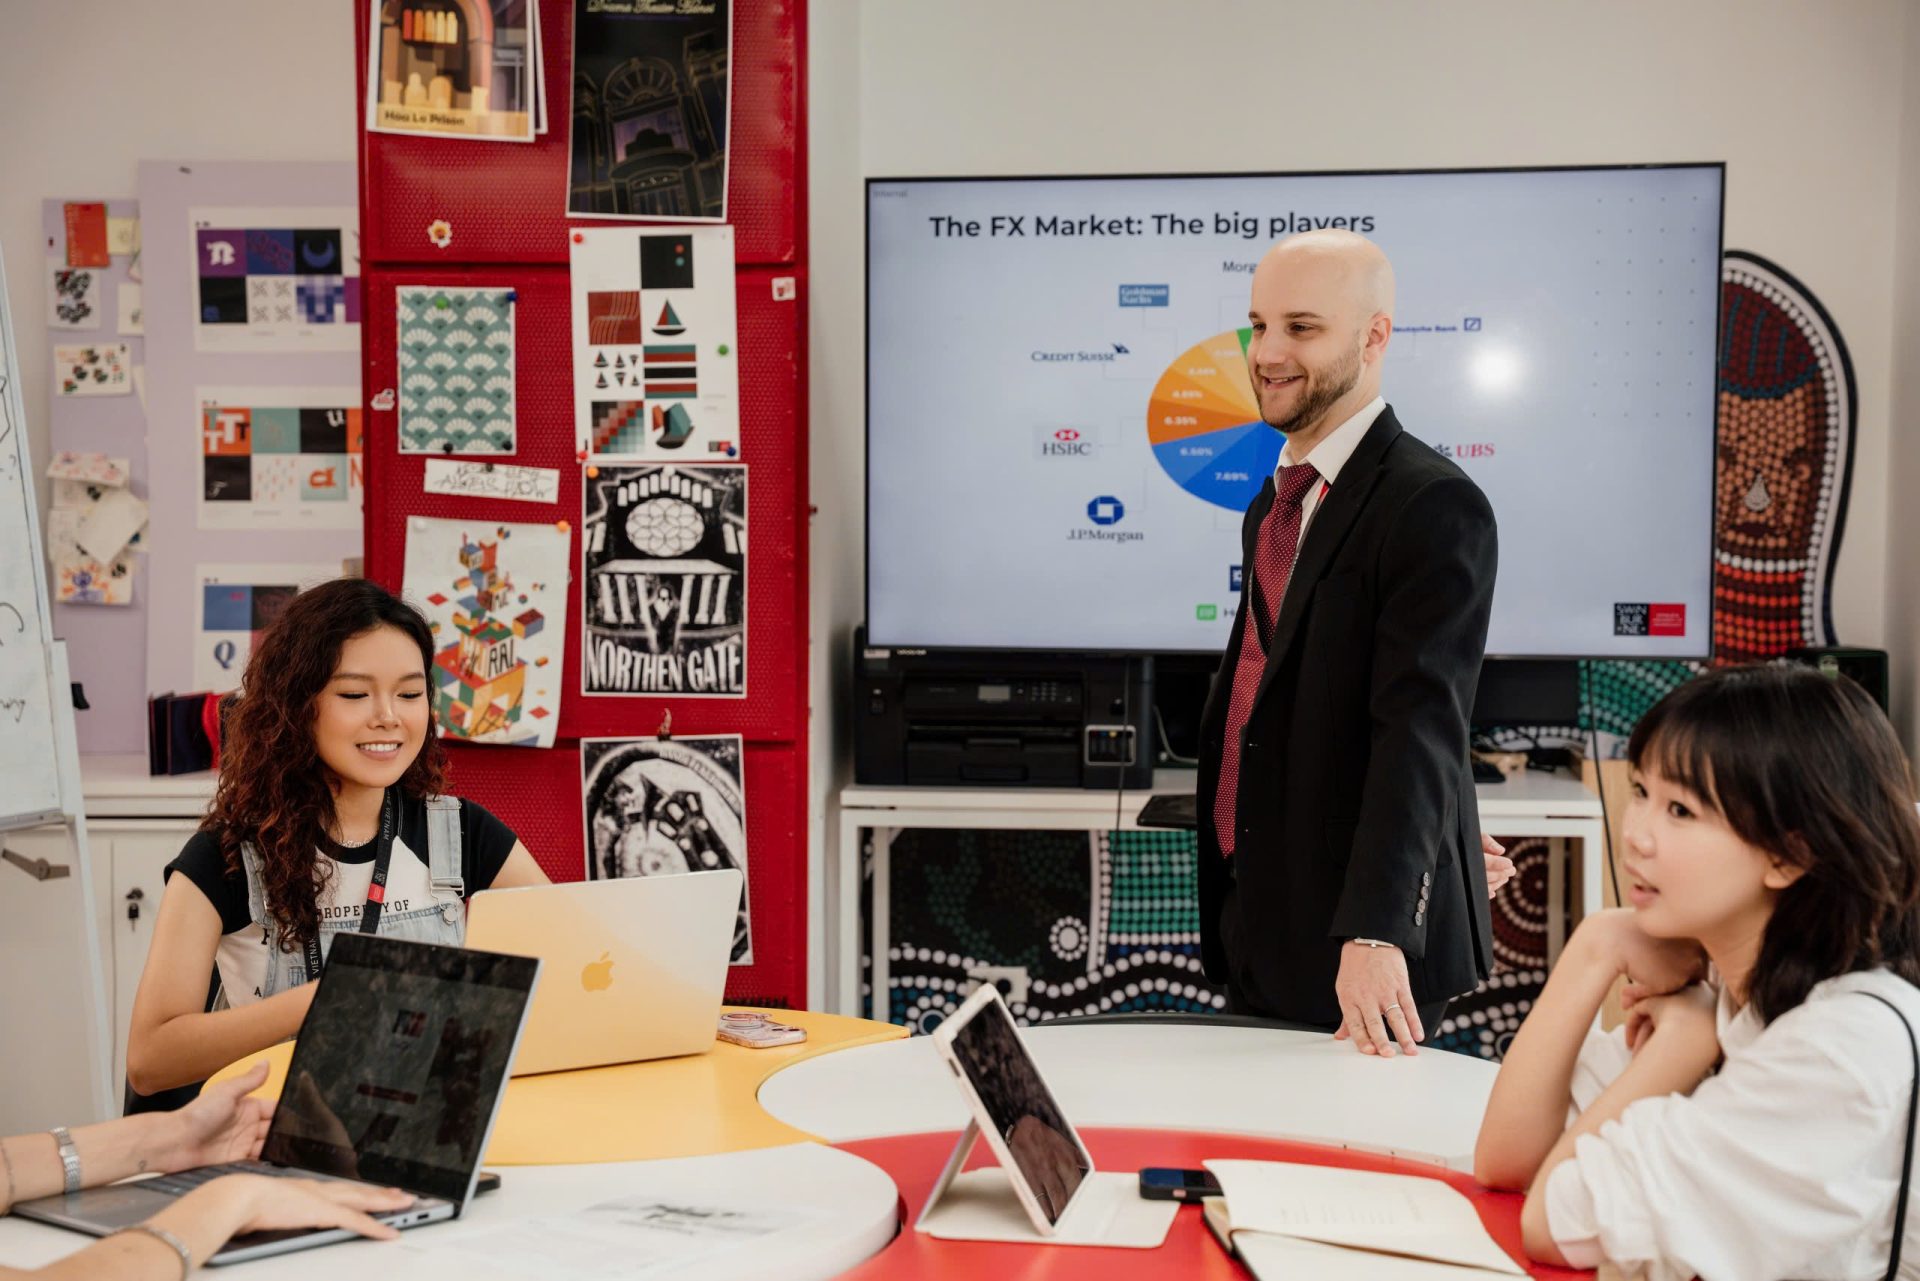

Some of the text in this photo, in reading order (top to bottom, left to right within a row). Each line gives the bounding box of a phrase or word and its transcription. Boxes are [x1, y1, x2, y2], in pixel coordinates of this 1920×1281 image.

[929, 216, 981, 237] The
[991, 215, 1025, 237] FX
[1035, 214, 1143, 236] Market:
[1151, 213, 1205, 235] The
[1214, 211, 1258, 239] big
[1222, 261, 1257, 273] Morg
[1042, 442, 1092, 456] HSBC
[1456, 443, 1496, 458] UBS
[585, 629, 743, 692] NORTHEN GATE
[324, 899, 409, 919] ROPEY OF
